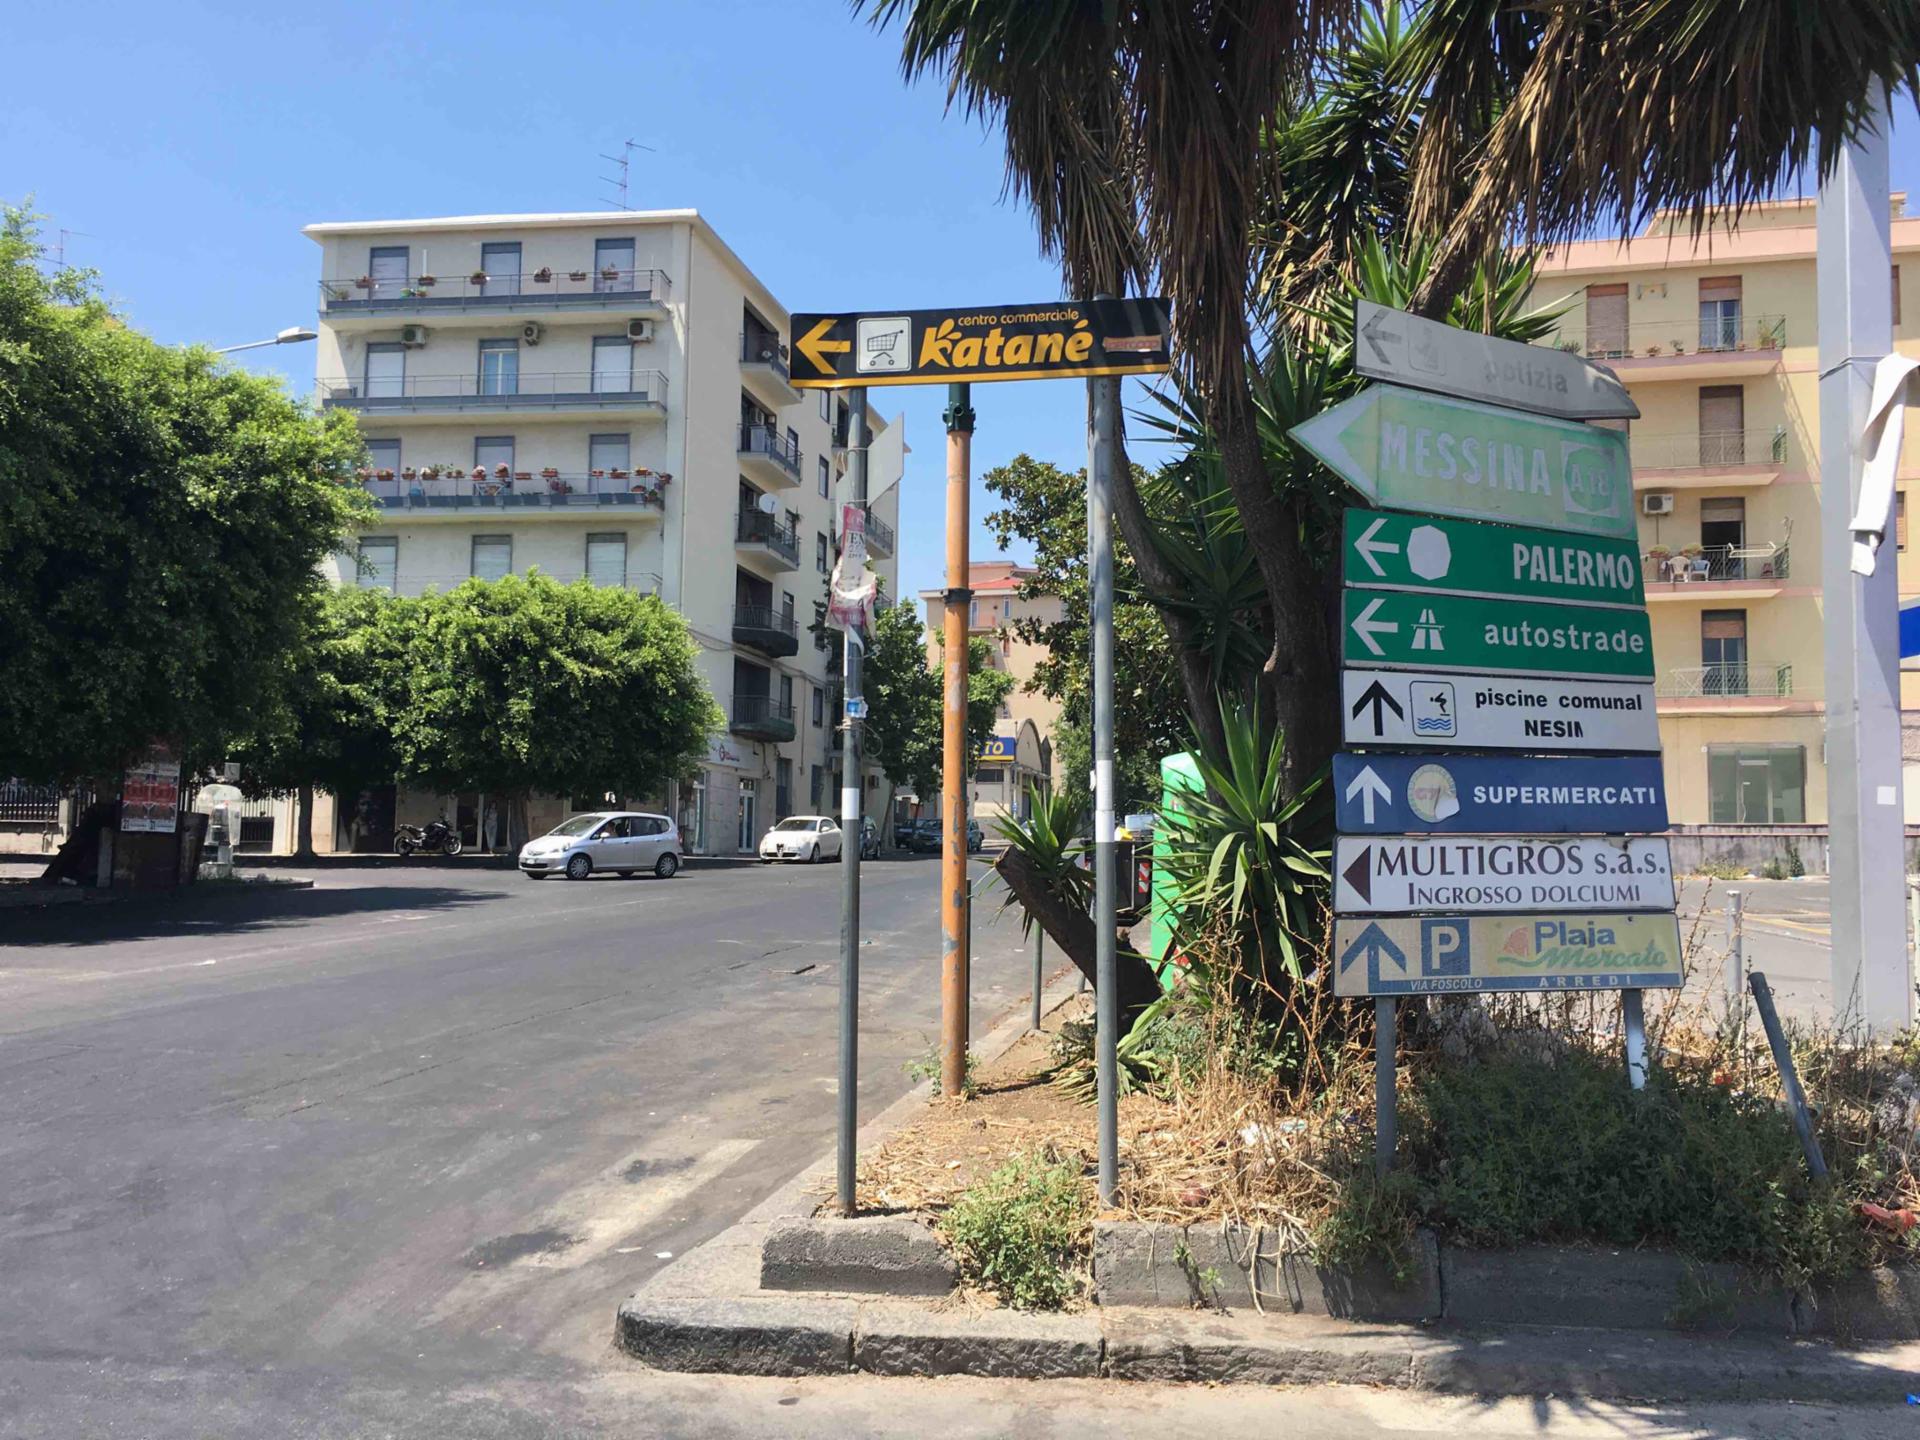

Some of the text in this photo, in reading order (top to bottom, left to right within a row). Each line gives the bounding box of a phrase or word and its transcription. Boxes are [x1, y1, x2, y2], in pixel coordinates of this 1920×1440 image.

[958, 309, 1079, 327] centro commerciale
[1380, 421, 1551, 496] MESSINA
[1512, 543, 1634, 590] PALERMO
[1484, 620, 1644, 653] autostrade
[1475, 688, 1548, 709] piscine
[1473, 785, 1656, 805] SUPERMERCATI
[1377, 845, 1666, 877] MULTIGROS s.a.s.
[1531, 885, 1640, 903] DOLCIUMI
[1431, 925, 1460, 971] P
[1534, 921, 1616, 954] Plaja
[1543, 939, 1668, 969] Mercato
[1411, 978, 1483, 991] VIA FOSCOLO
[1539, 975, 1632, 988] ARREDI
